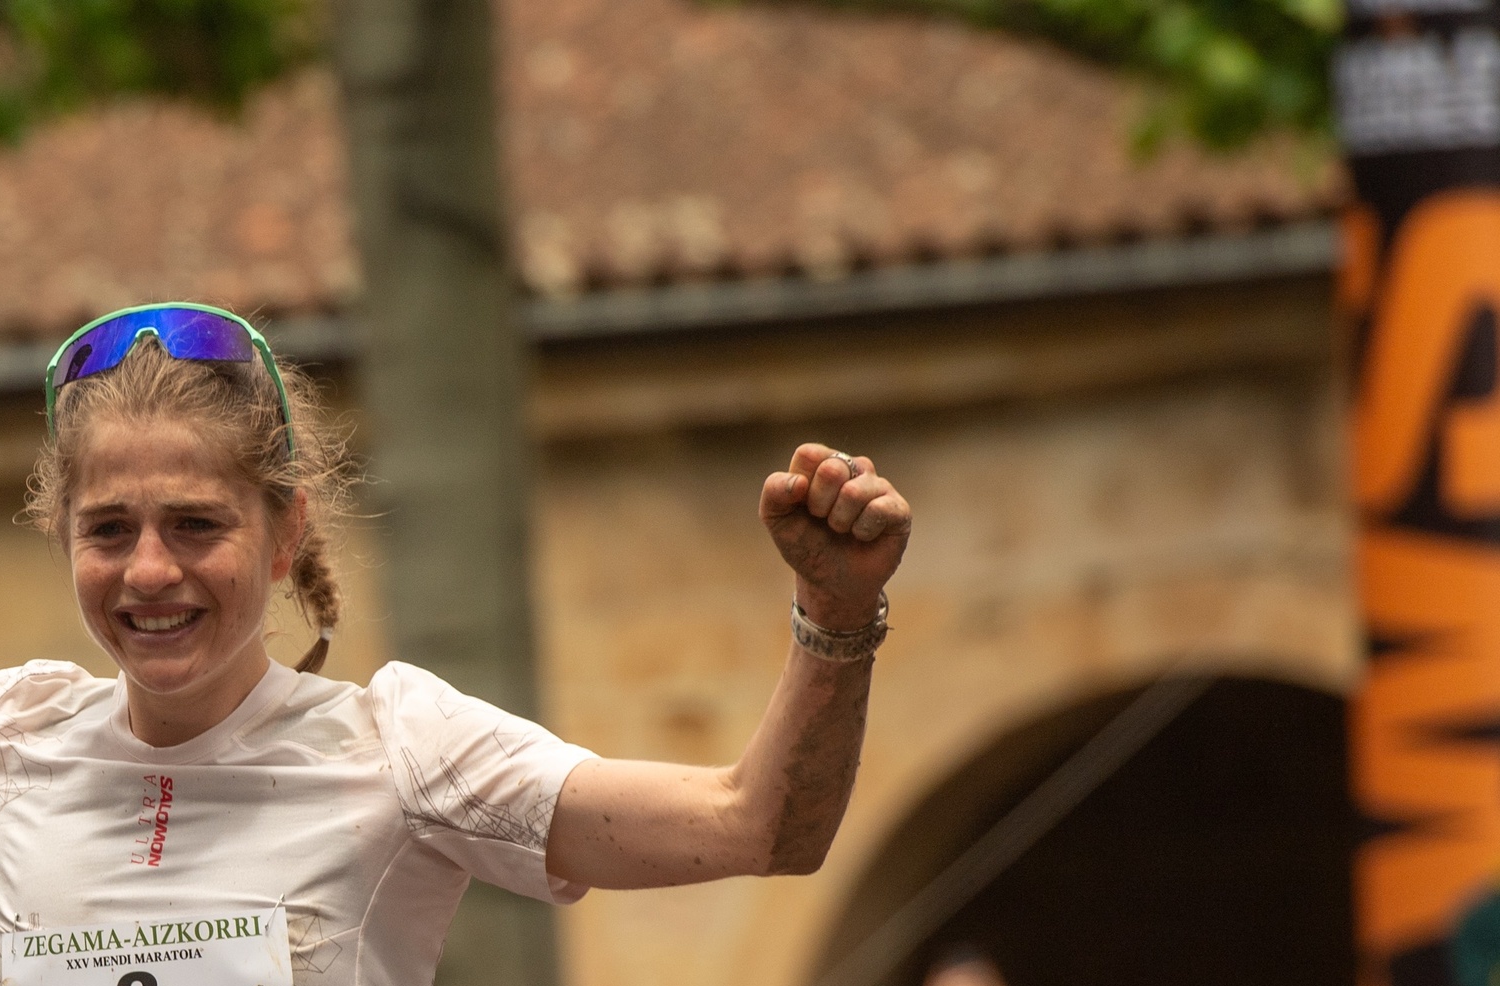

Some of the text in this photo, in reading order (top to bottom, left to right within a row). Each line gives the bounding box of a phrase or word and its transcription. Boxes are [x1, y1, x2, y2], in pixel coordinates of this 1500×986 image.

[148, 775, 173, 867] SALOMON
[23, 915, 263, 957] ZEGAMA-AIZKORRI
[66, 948, 202, 970] XXV MENDI MARATOIA
